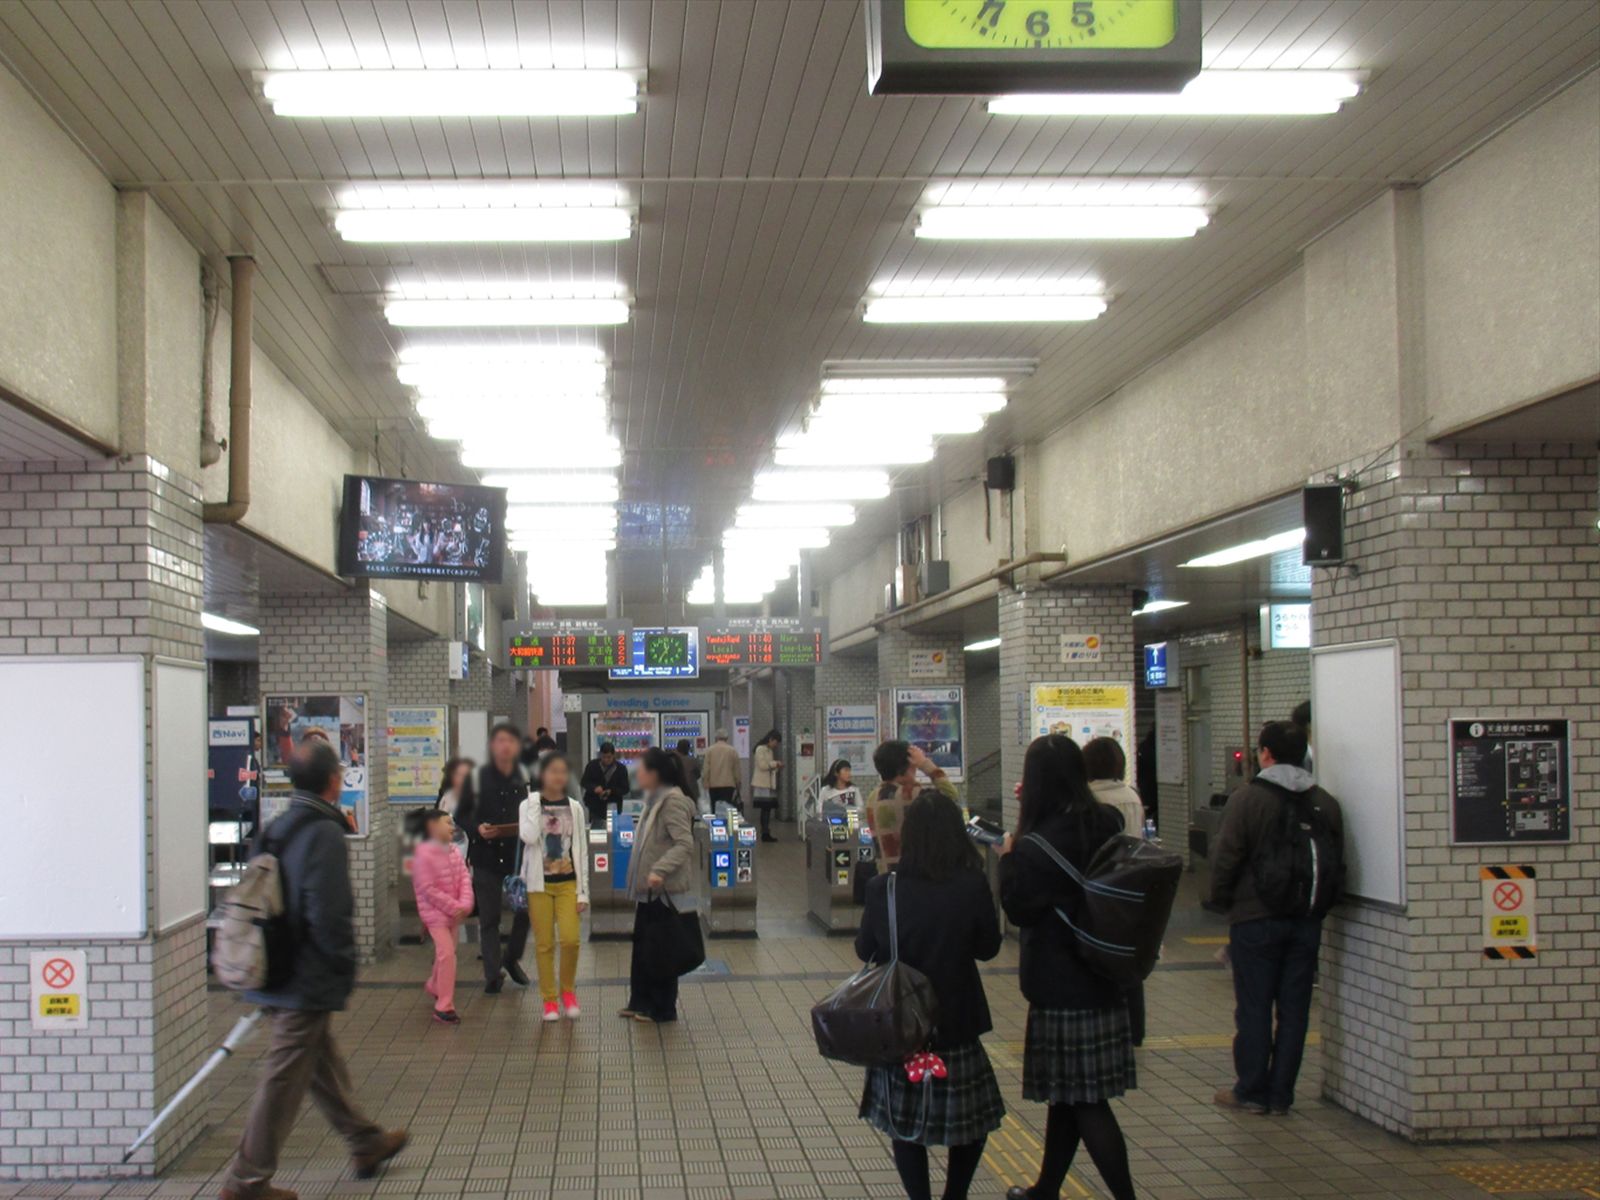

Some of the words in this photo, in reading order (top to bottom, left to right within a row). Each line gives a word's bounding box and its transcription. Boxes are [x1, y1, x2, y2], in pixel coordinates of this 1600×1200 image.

[977, 0, 1005, 28] 7
[1071, 1, 1095, 28] 5
[1025, 11, 1050, 38] 6
[551, 646, 576, 656] 11:41
[607, 697, 649, 709] Vending
[653, 697, 690, 707] Corner
[716, 854, 728, 867] IC
